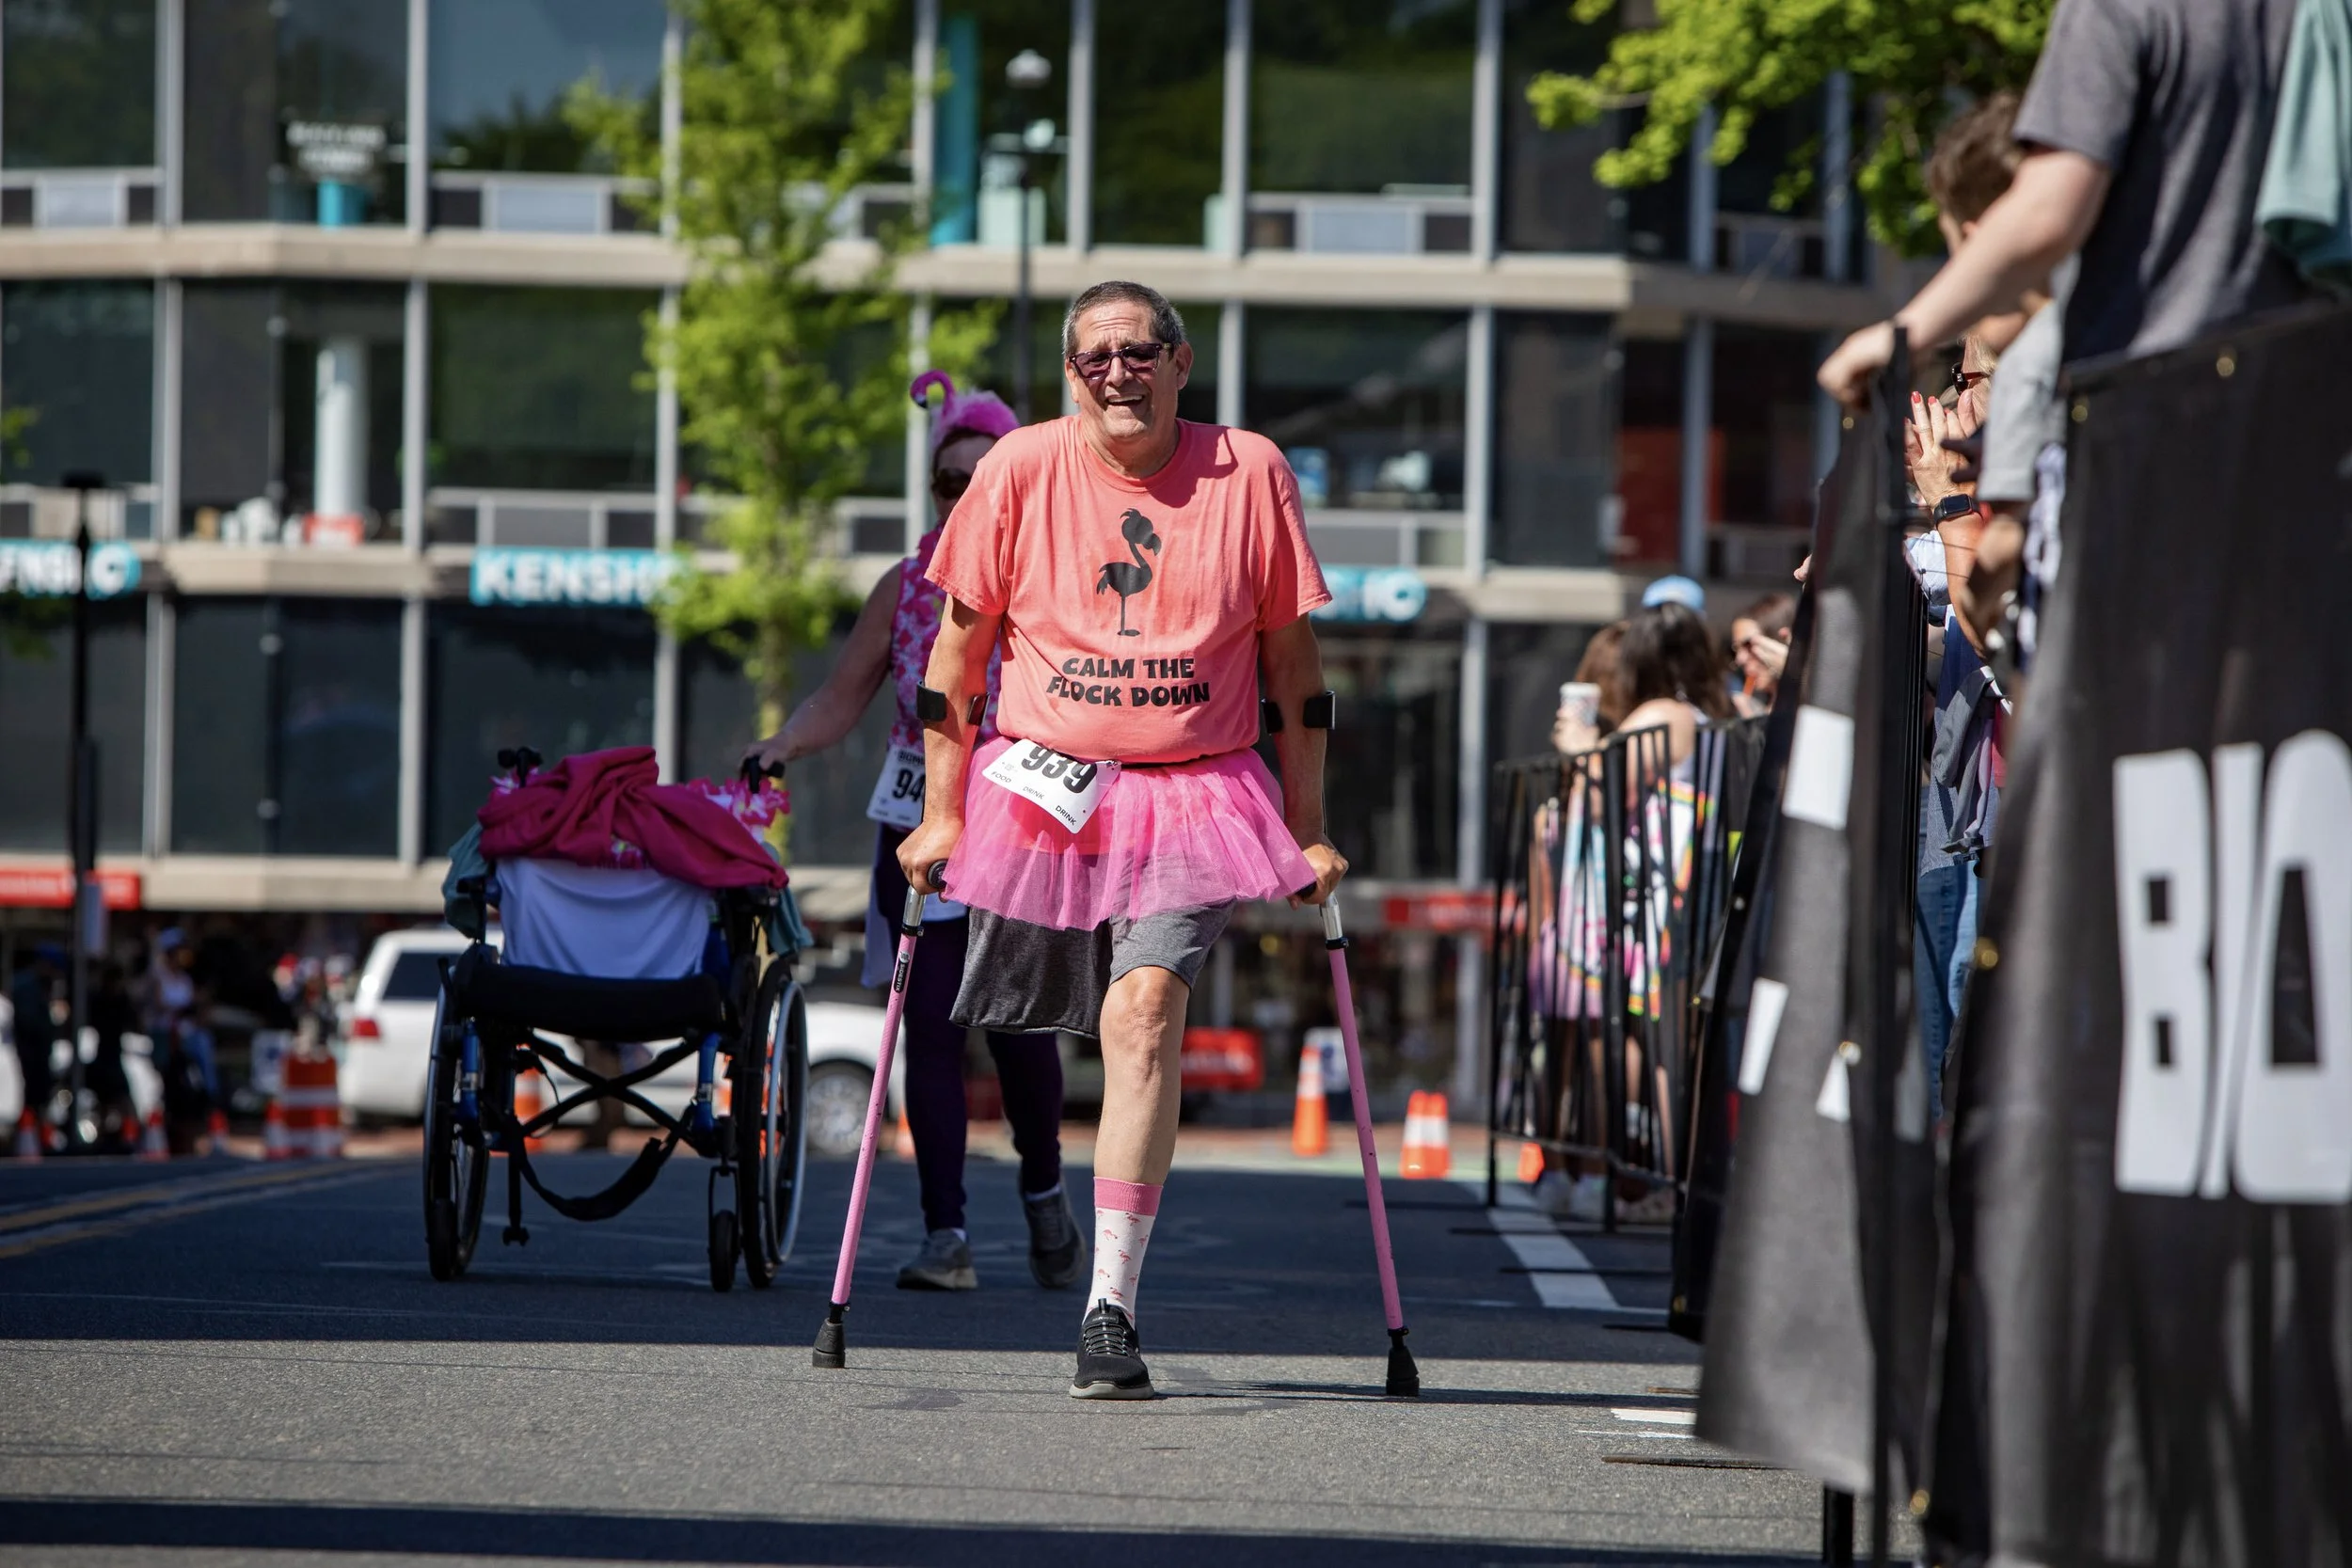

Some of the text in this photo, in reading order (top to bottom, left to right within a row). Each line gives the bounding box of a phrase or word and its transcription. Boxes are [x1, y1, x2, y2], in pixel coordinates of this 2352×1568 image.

[1062, 657, 1195, 678] CALM THE
[1046, 675, 1211, 706] FLOCK DOWN
[991, 771, 1012, 784] FOOD
[1021, 745, 1098, 794] 939
[1022, 785, 1045, 800] DRINK
[1055, 804, 1077, 826] DRINK
